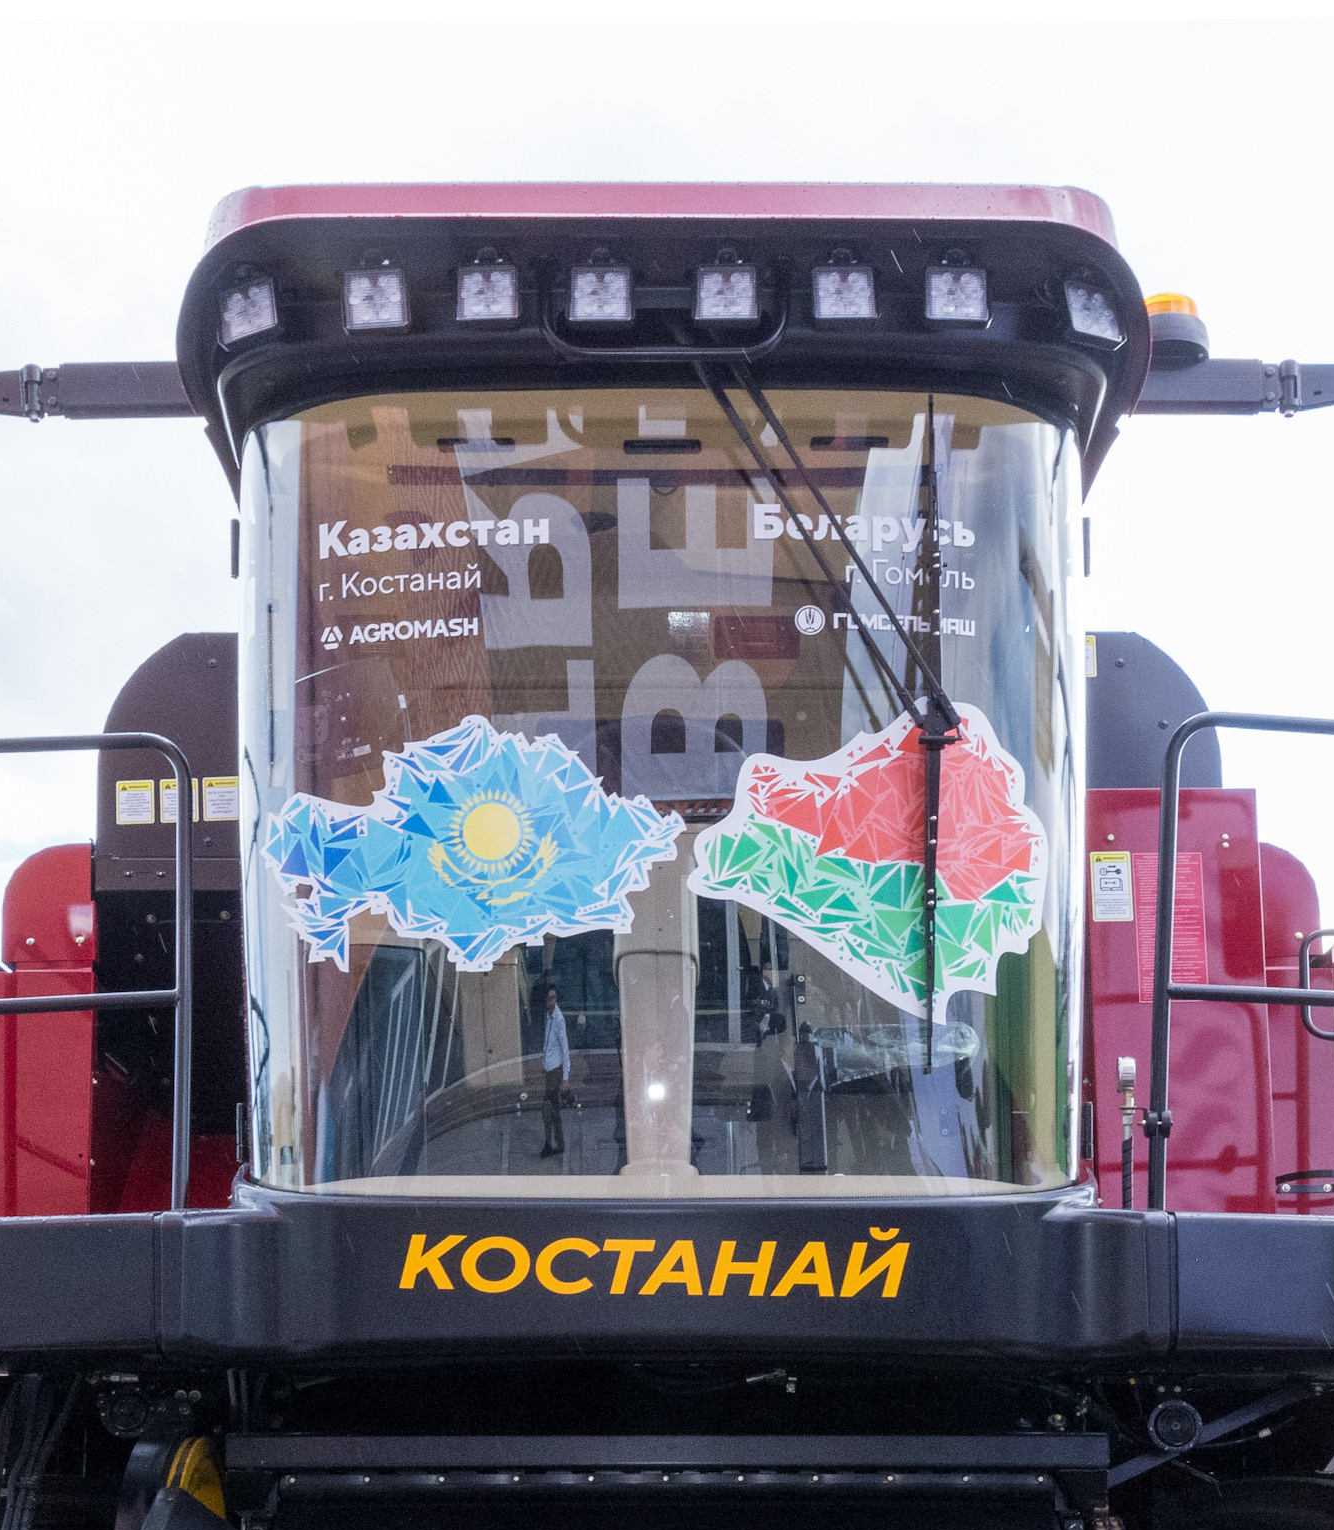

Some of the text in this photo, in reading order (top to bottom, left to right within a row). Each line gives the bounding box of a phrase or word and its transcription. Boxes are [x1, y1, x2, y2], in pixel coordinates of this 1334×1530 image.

[318, 518, 550, 560] Казахстан
[319, 563, 482, 602] г. Костанай
[845, 559, 975, 590] г. Гомль
[349, 617, 479, 645] AGROMASH
[399, 1227, 911, 1299] КОСТАНАЙ
